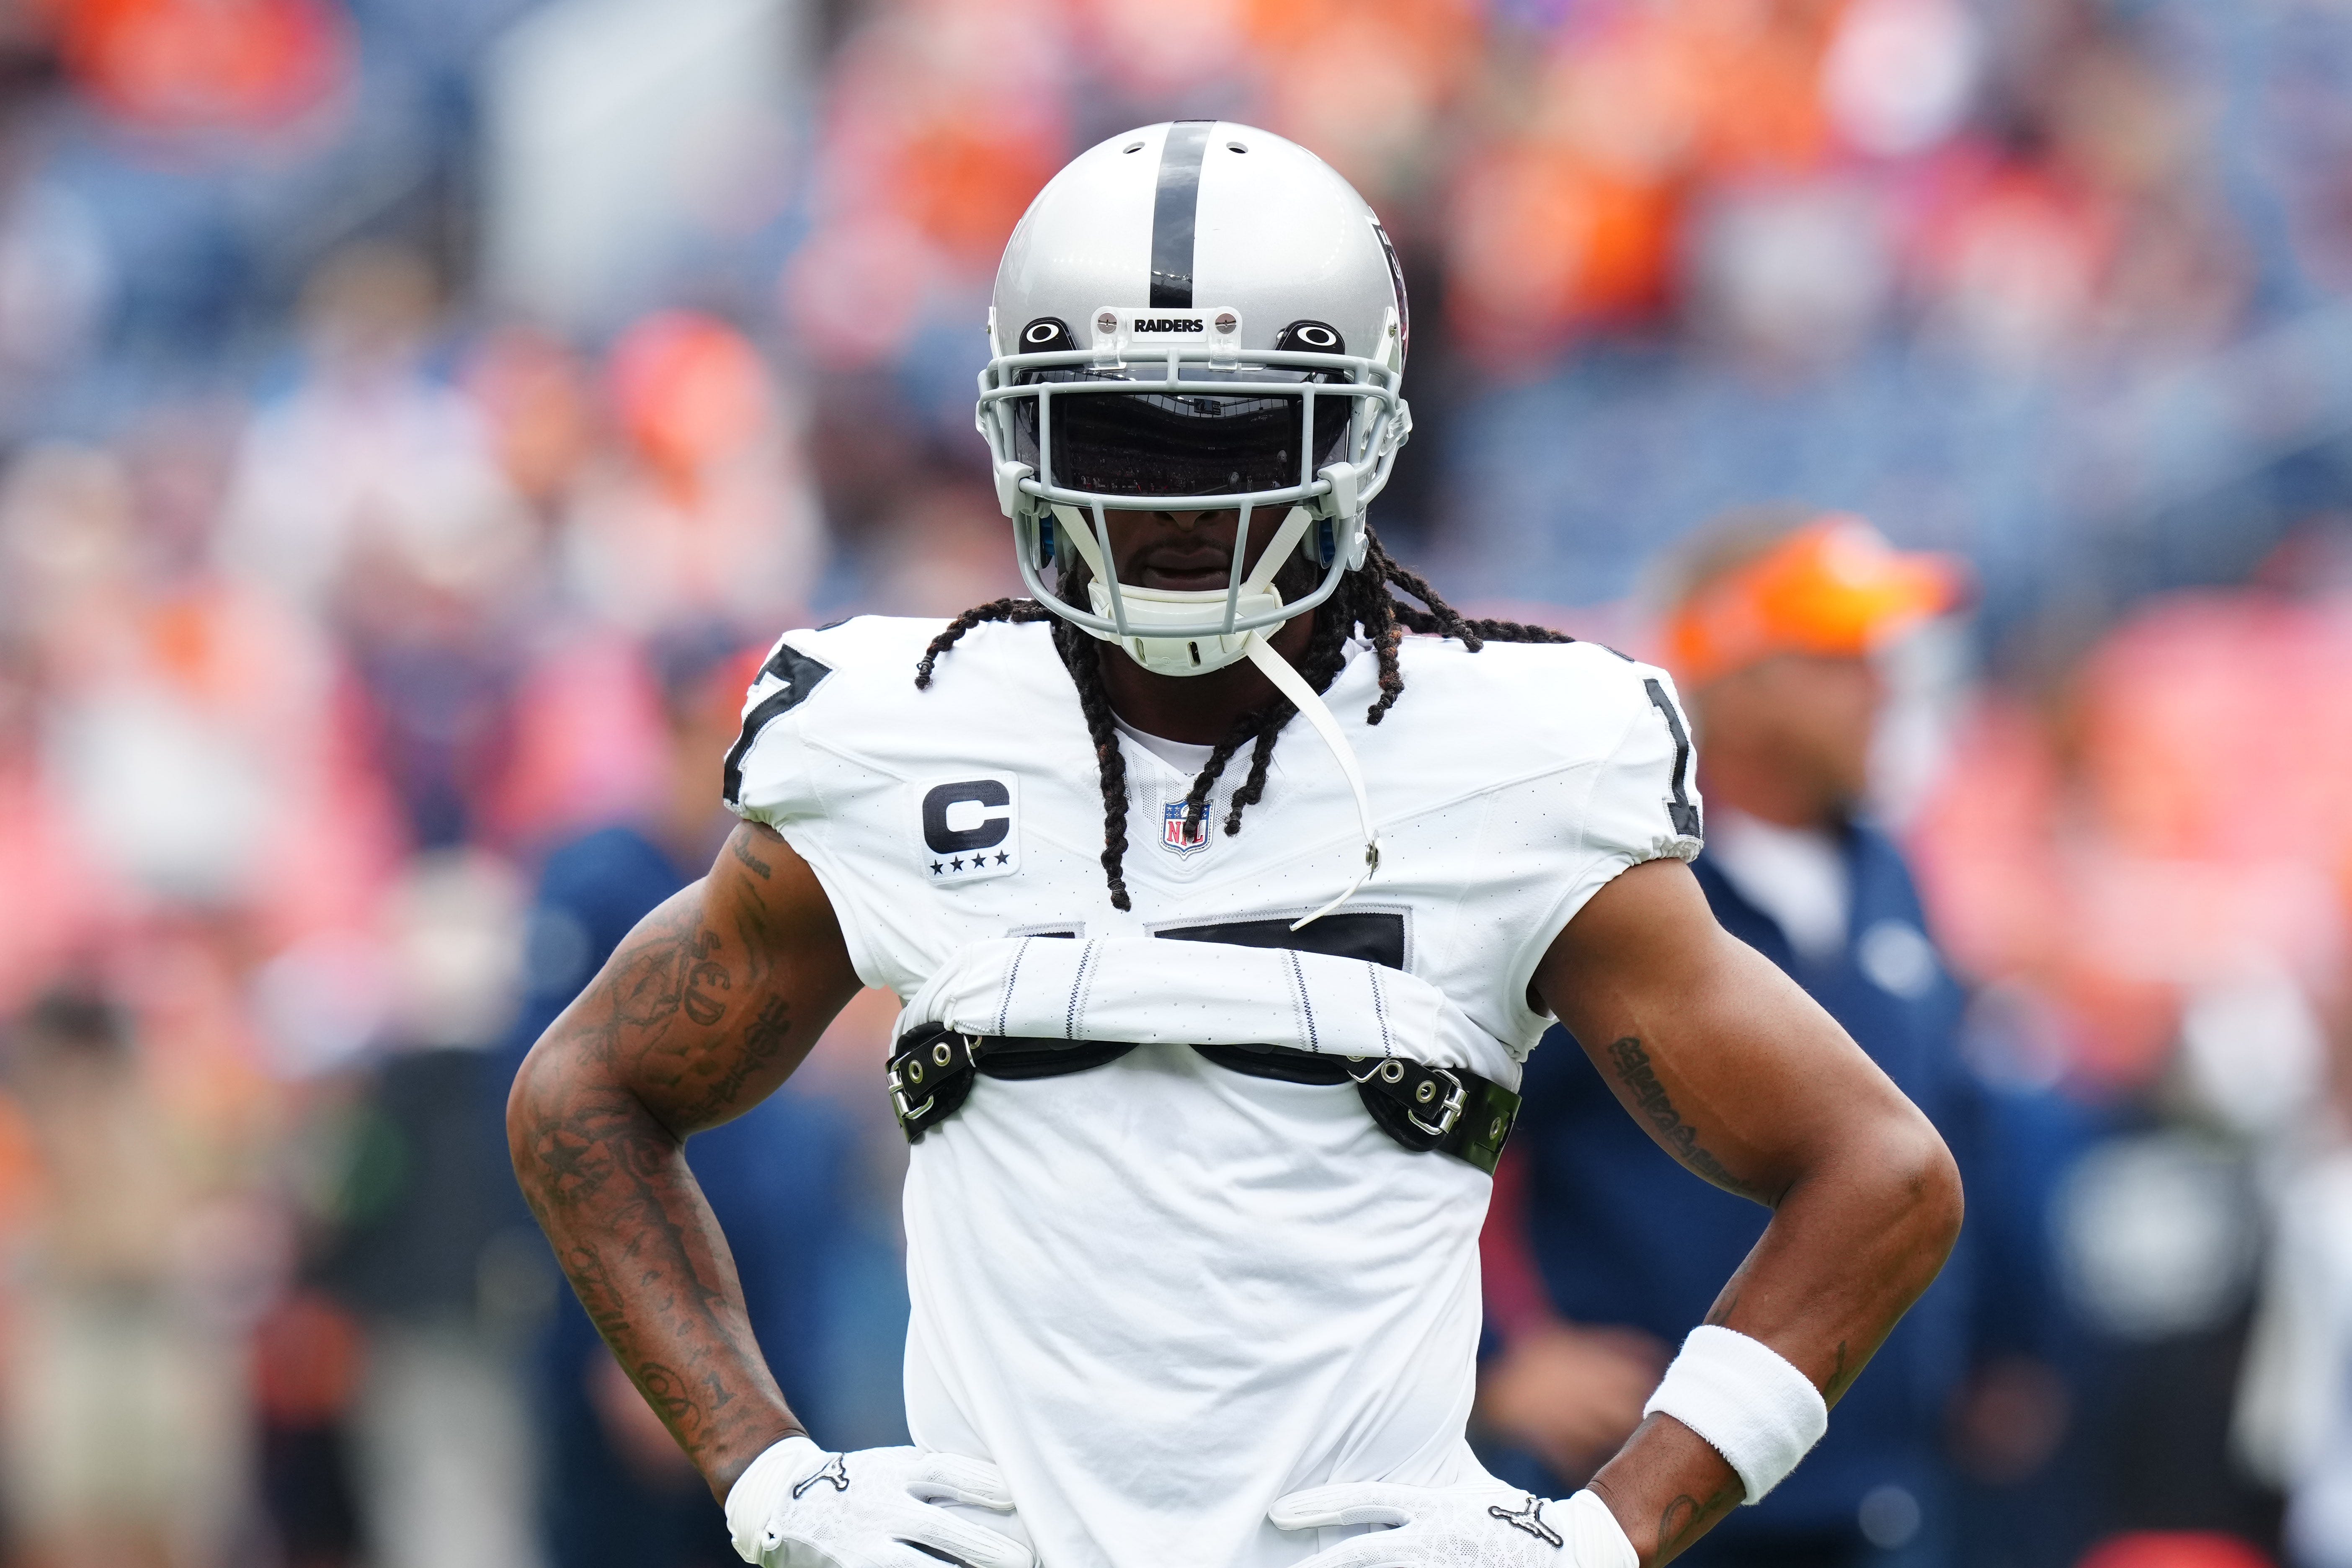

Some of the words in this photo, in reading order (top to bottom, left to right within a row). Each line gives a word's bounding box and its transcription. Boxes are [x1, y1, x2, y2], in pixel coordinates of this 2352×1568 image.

[1135, 319, 1203, 332] RAIDERS
[722, 644, 833, 805] 7
[1643, 678, 1701, 838] 1
[923, 779, 1010, 854] C
